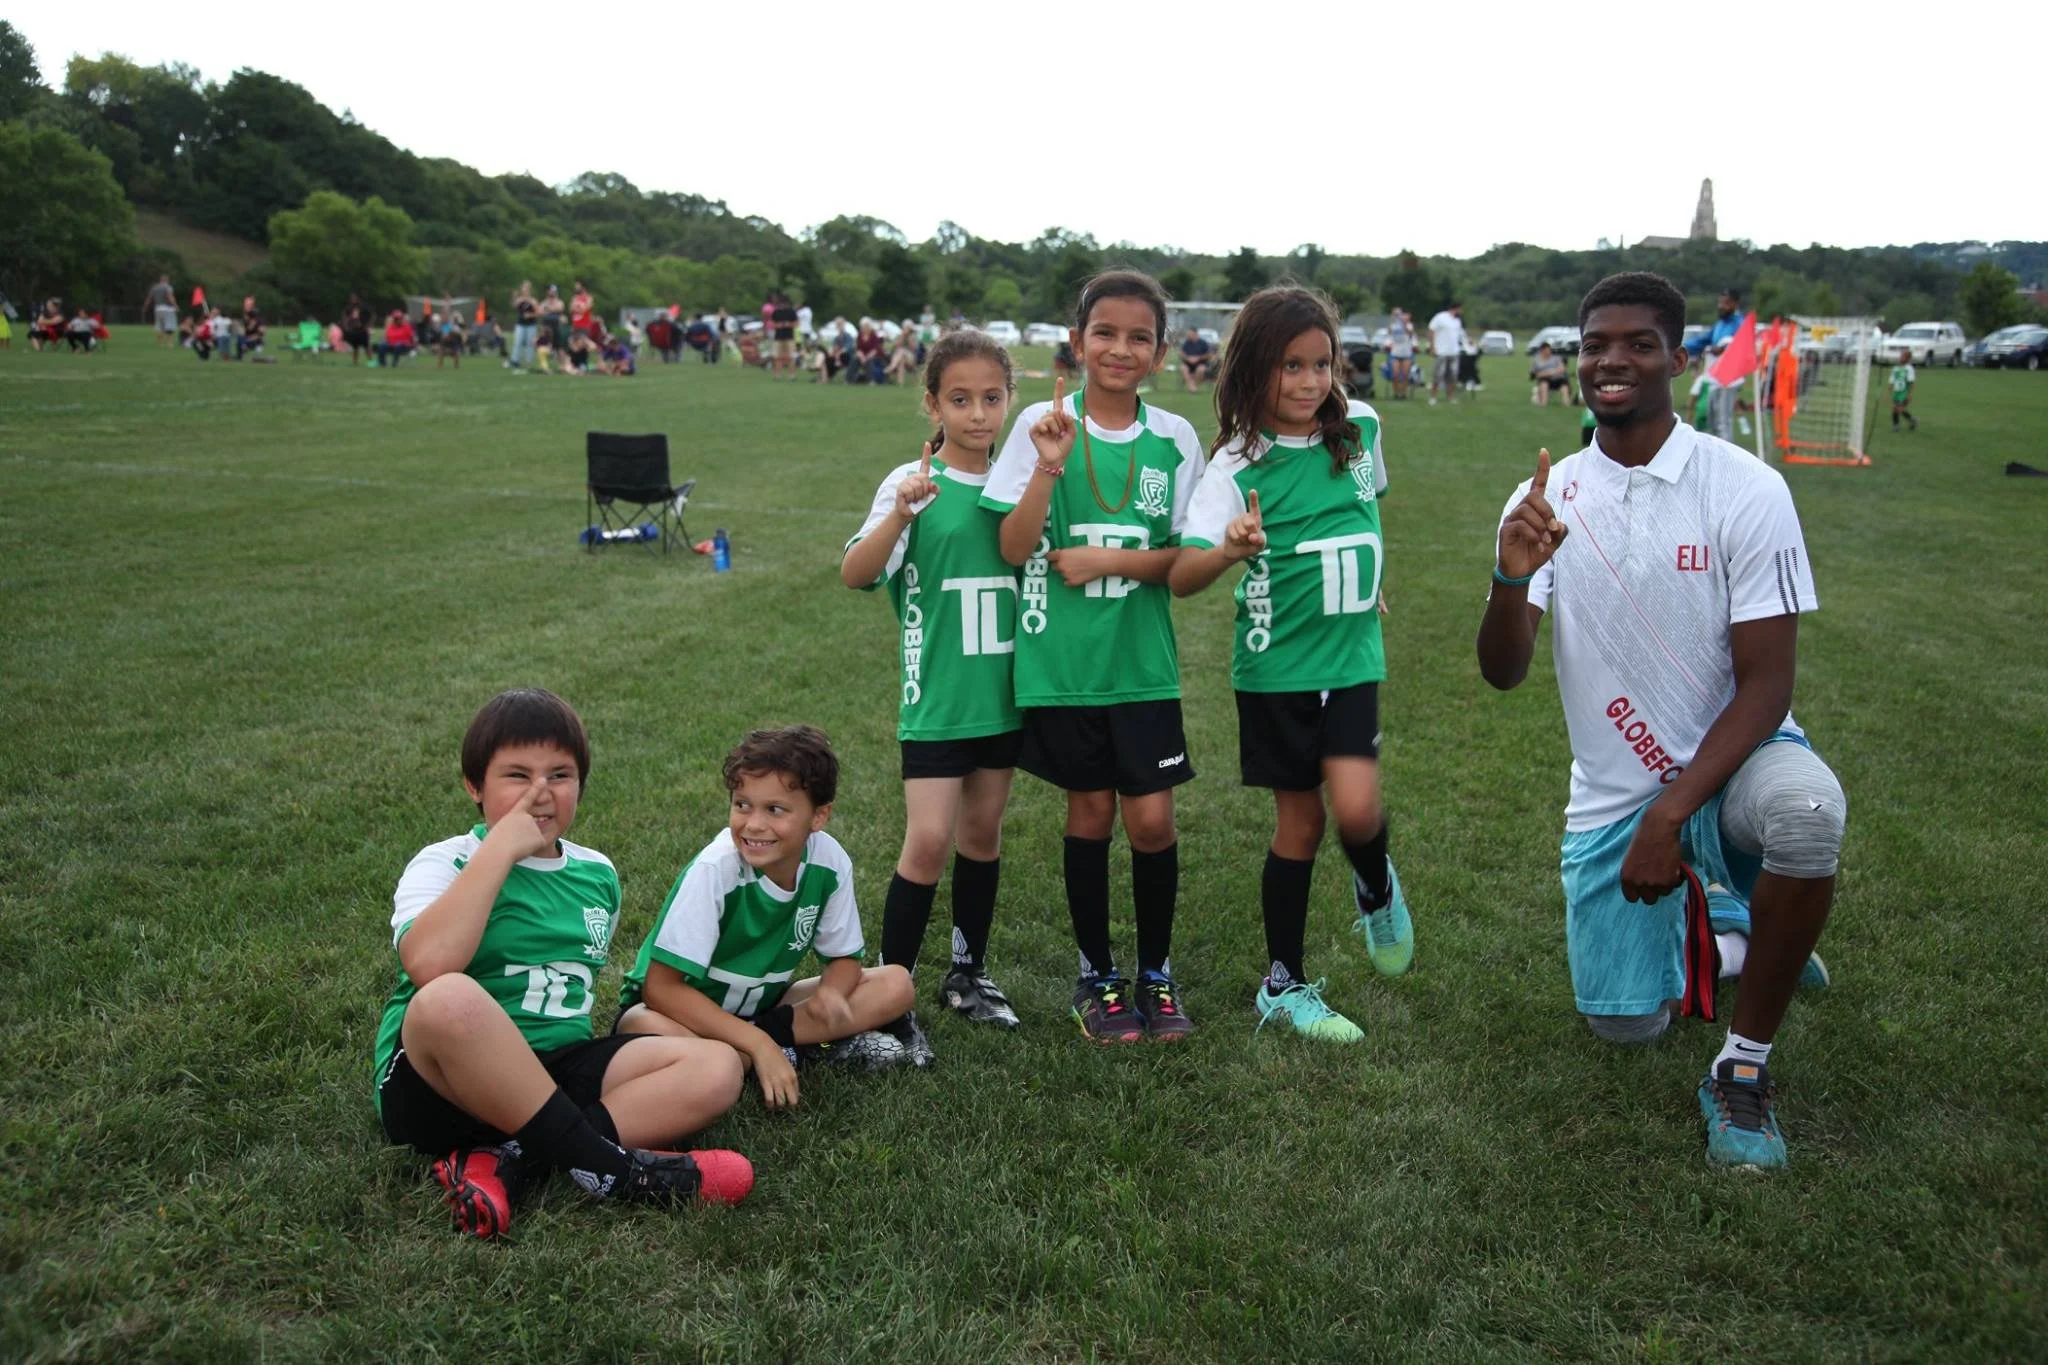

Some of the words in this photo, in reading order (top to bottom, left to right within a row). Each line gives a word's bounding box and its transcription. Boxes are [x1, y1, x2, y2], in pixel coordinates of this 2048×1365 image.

[1021, 503, 1051, 635] OBEFC
[1245, 530, 1273, 653] OBEFC
[1295, 532, 1383, 616] TD
[1677, 544, 1709, 571] ELI
[904, 562, 924, 705] GLOBEFC
[941, 576, 1020, 656] TD
[1606, 697, 1684, 784] GLOBEFC
